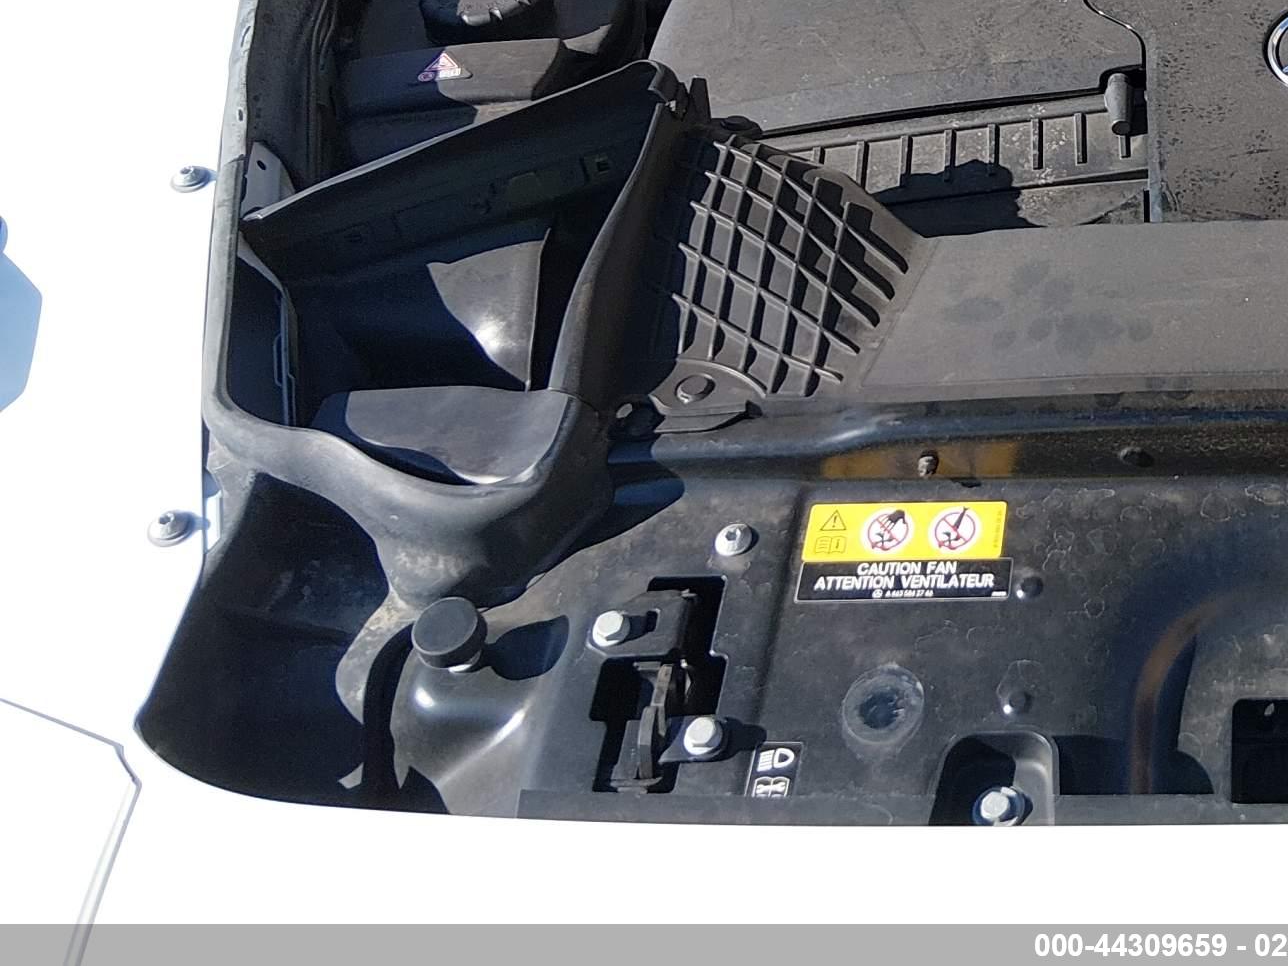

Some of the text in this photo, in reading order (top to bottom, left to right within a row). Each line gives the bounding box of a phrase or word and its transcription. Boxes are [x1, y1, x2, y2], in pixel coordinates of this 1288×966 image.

[857, 561, 958, 575] CAUTION FAN
[813, 573, 995, 591] ATTENTION VENTILATEUR
